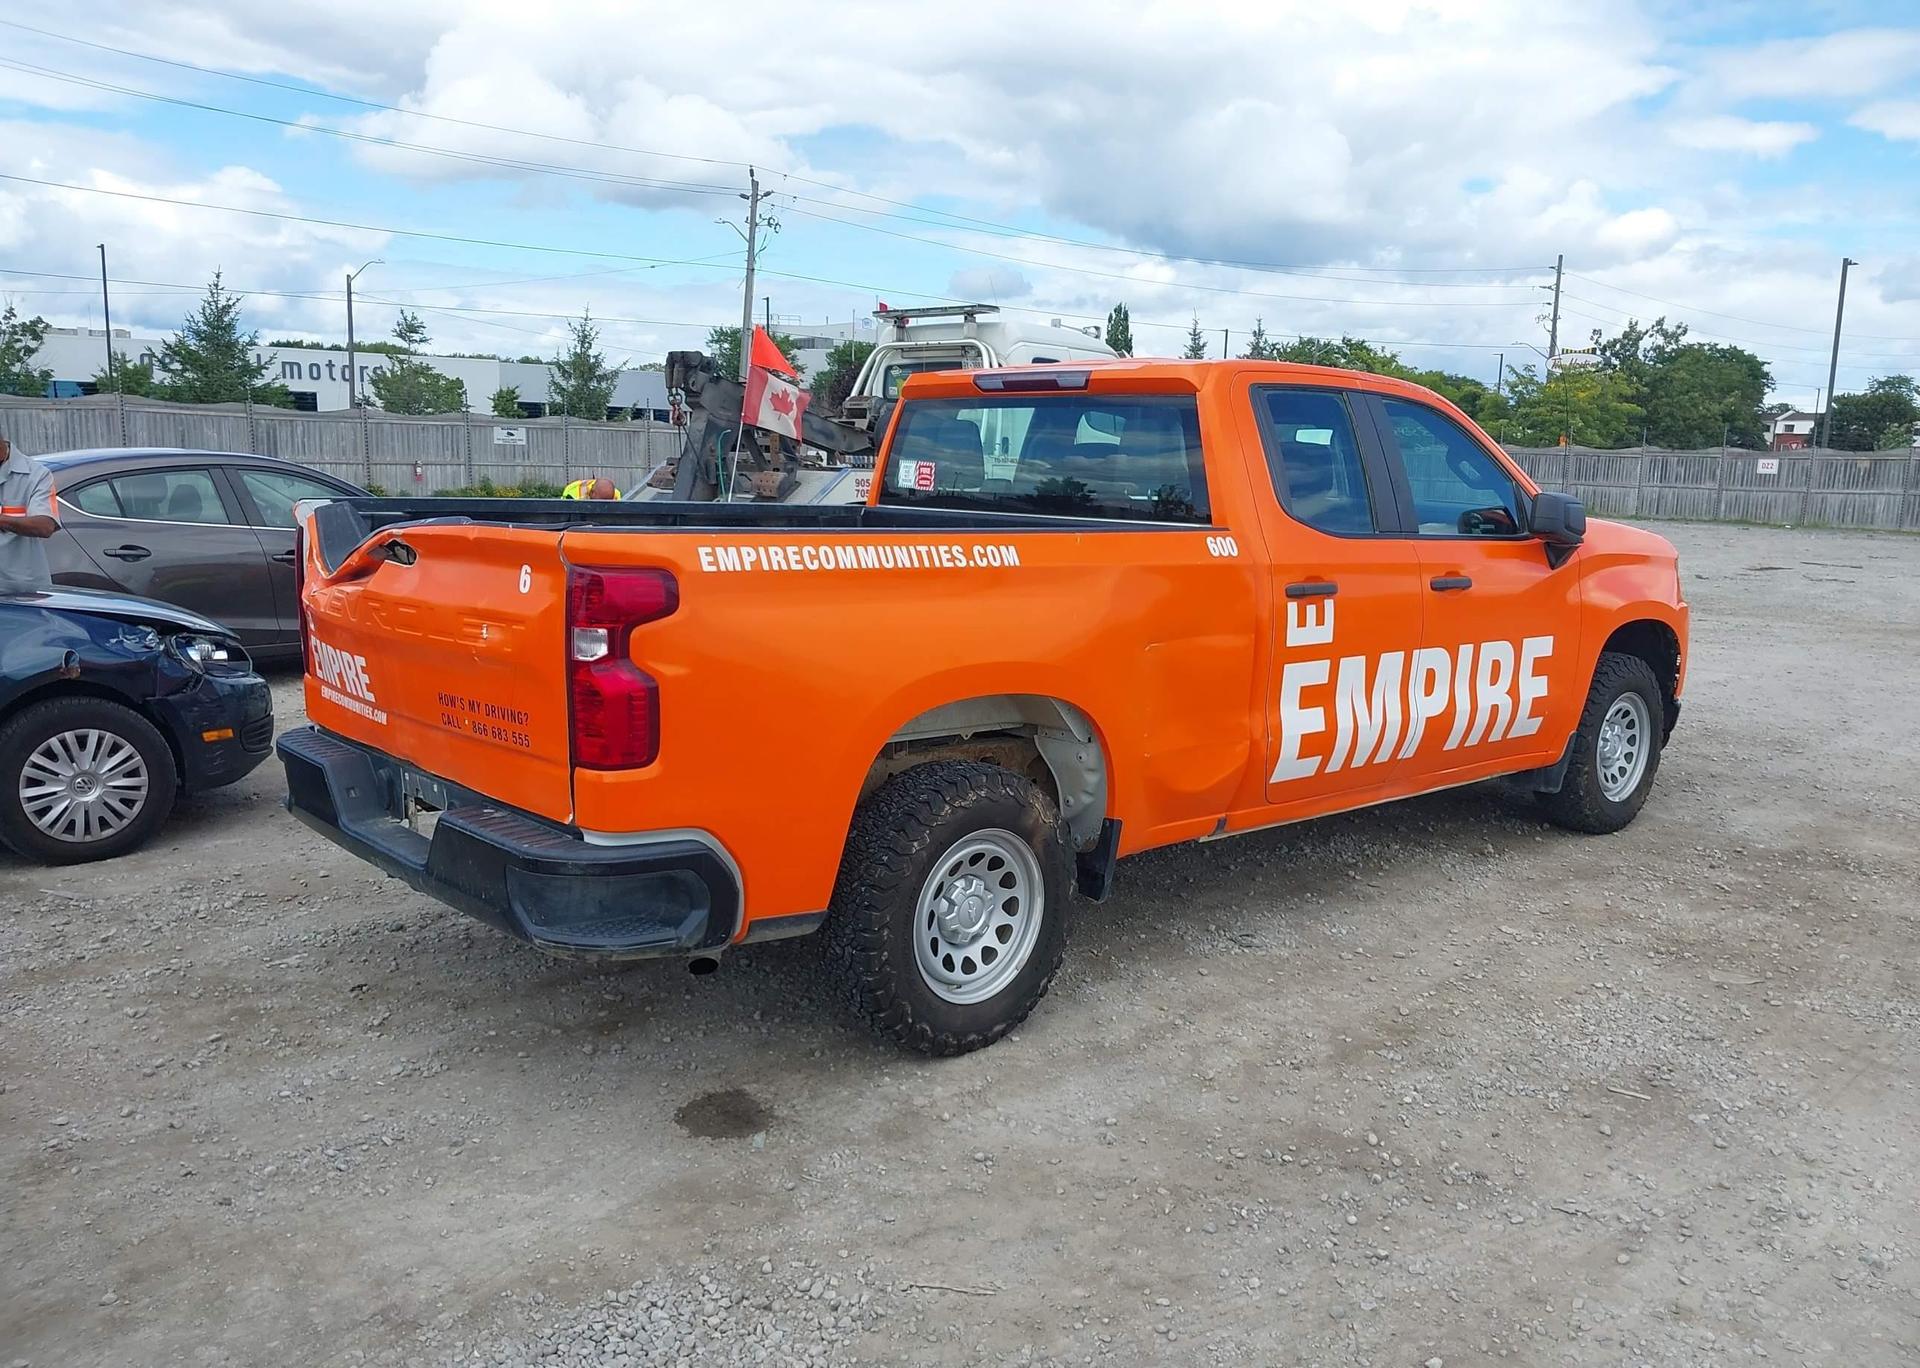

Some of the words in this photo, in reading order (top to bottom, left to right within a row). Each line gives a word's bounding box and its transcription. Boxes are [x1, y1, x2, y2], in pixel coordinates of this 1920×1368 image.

[854, 478, 871, 488] 905
[697, 545, 1020, 572] EMPIRECOMMUNITIES.COM
[1206, 536, 1239, 557] 600
[518, 564, 532, 593] 6
[310, 634, 376, 703] EMPIRE
[438, 692, 465, 711] HOW'S
[468, 698, 481, 715] MY
[484, 703, 529, 726] DRIVING?
[1269, 635, 1554, 784] EMPIRE
[441, 712, 462, 729] CALL
[472, 720, 489, 737] 866
[491, 725, 509, 742] 683
[512, 731, 530, 748] 555
